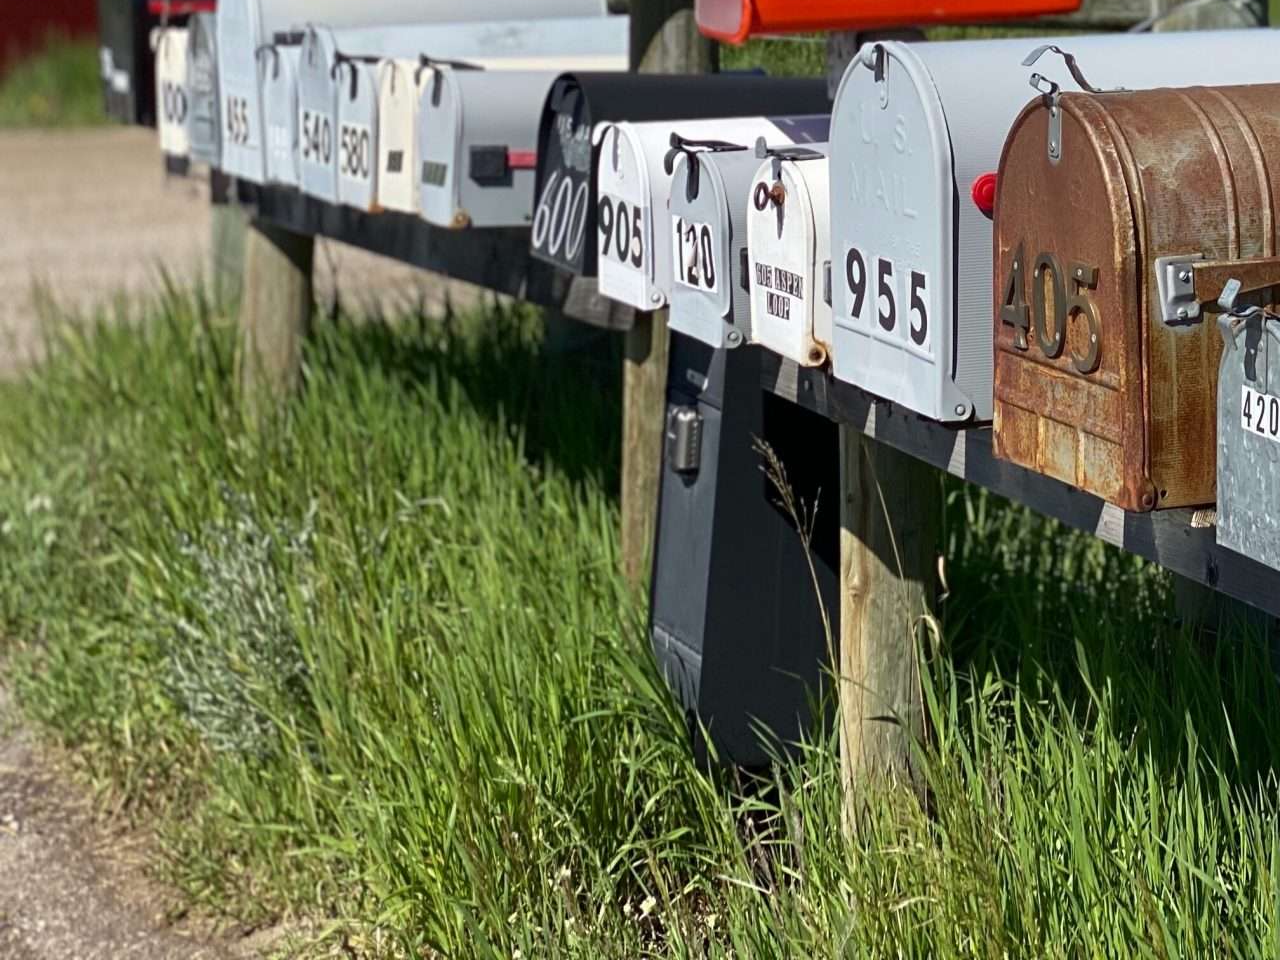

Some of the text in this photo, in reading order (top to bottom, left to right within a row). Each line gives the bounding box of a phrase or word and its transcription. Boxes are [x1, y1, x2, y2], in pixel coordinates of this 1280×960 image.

[303, 111, 332, 164] 540
[341, 124, 370, 180] 580
[531, 169, 590, 262] 600
[598, 194, 644, 269] 905
[676, 217, 716, 290] 120
[774, 266, 804, 300] ASPEN
[766, 291, 791, 321] LOOP
[846, 247, 928, 346] 955
[1001, 239, 1100, 375] 405
[1242, 391, 1280, 438] 420
